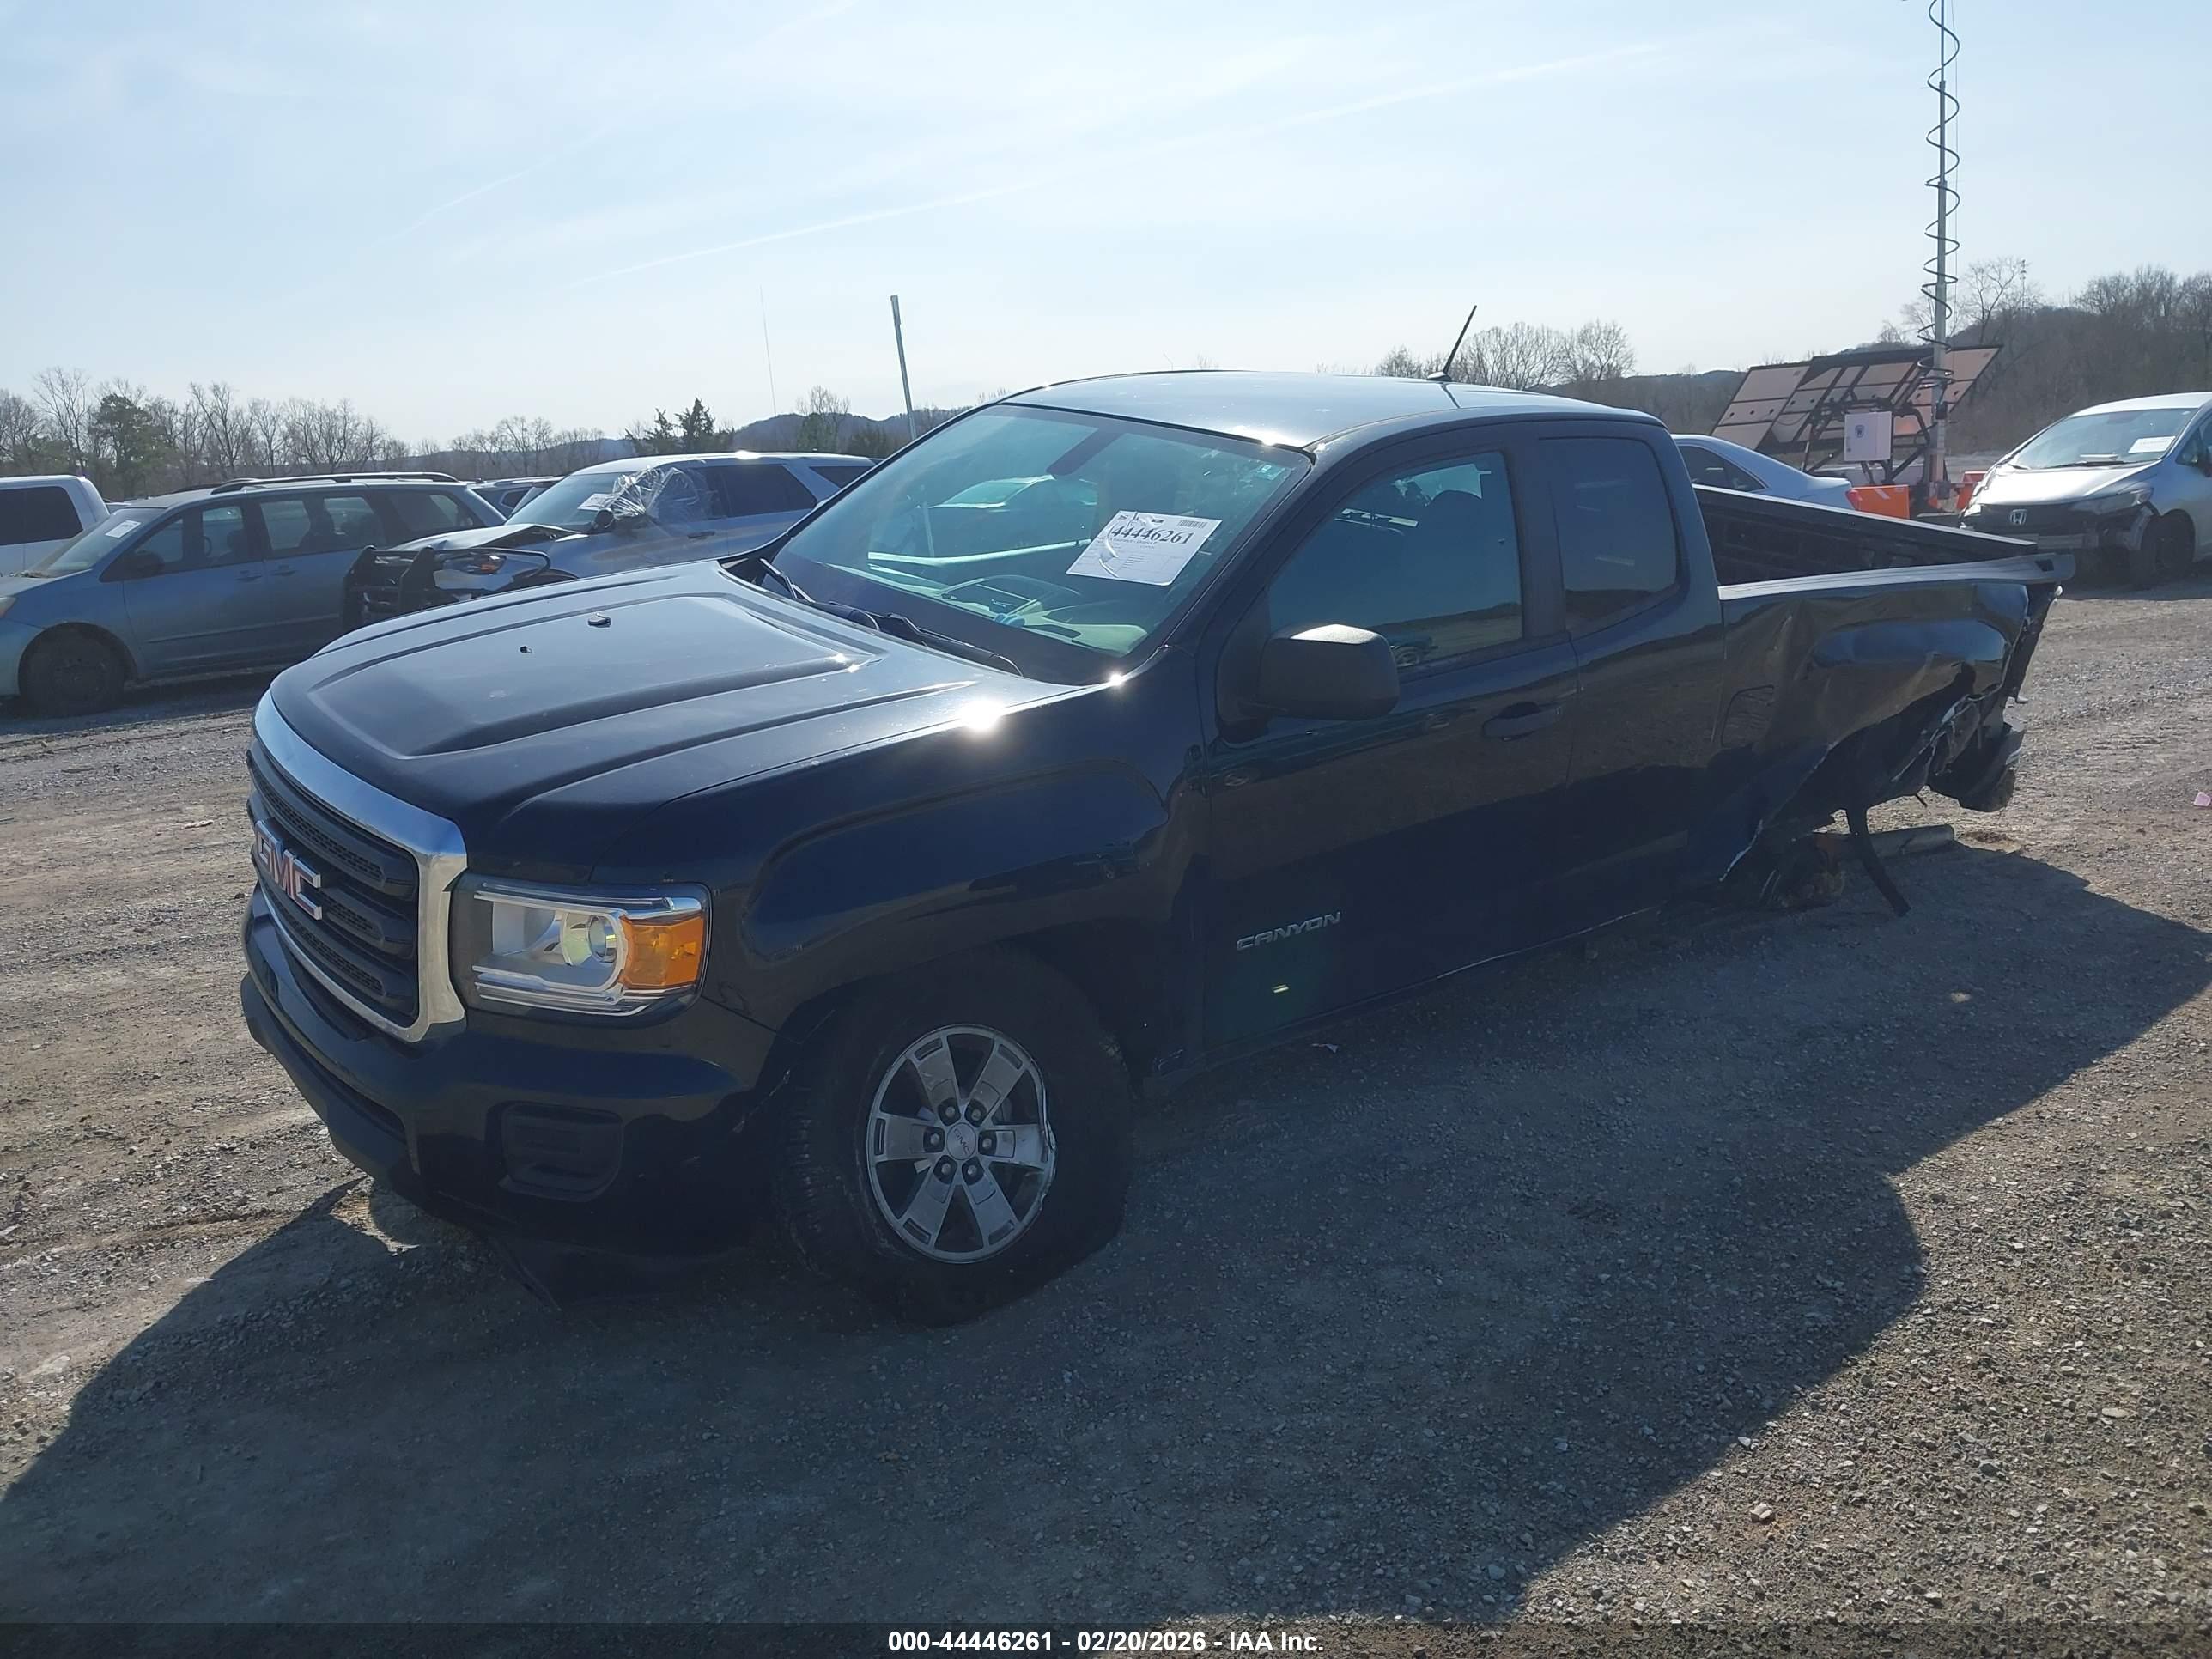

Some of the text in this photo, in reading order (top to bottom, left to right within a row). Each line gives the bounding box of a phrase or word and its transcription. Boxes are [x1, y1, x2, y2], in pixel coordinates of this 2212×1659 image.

[1112, 526, 1194, 545] 44446261
[256, 820, 323, 921] GMC
[1236, 911, 1341, 951] CANYON
[952, 1127, 971, 1156] GMC
